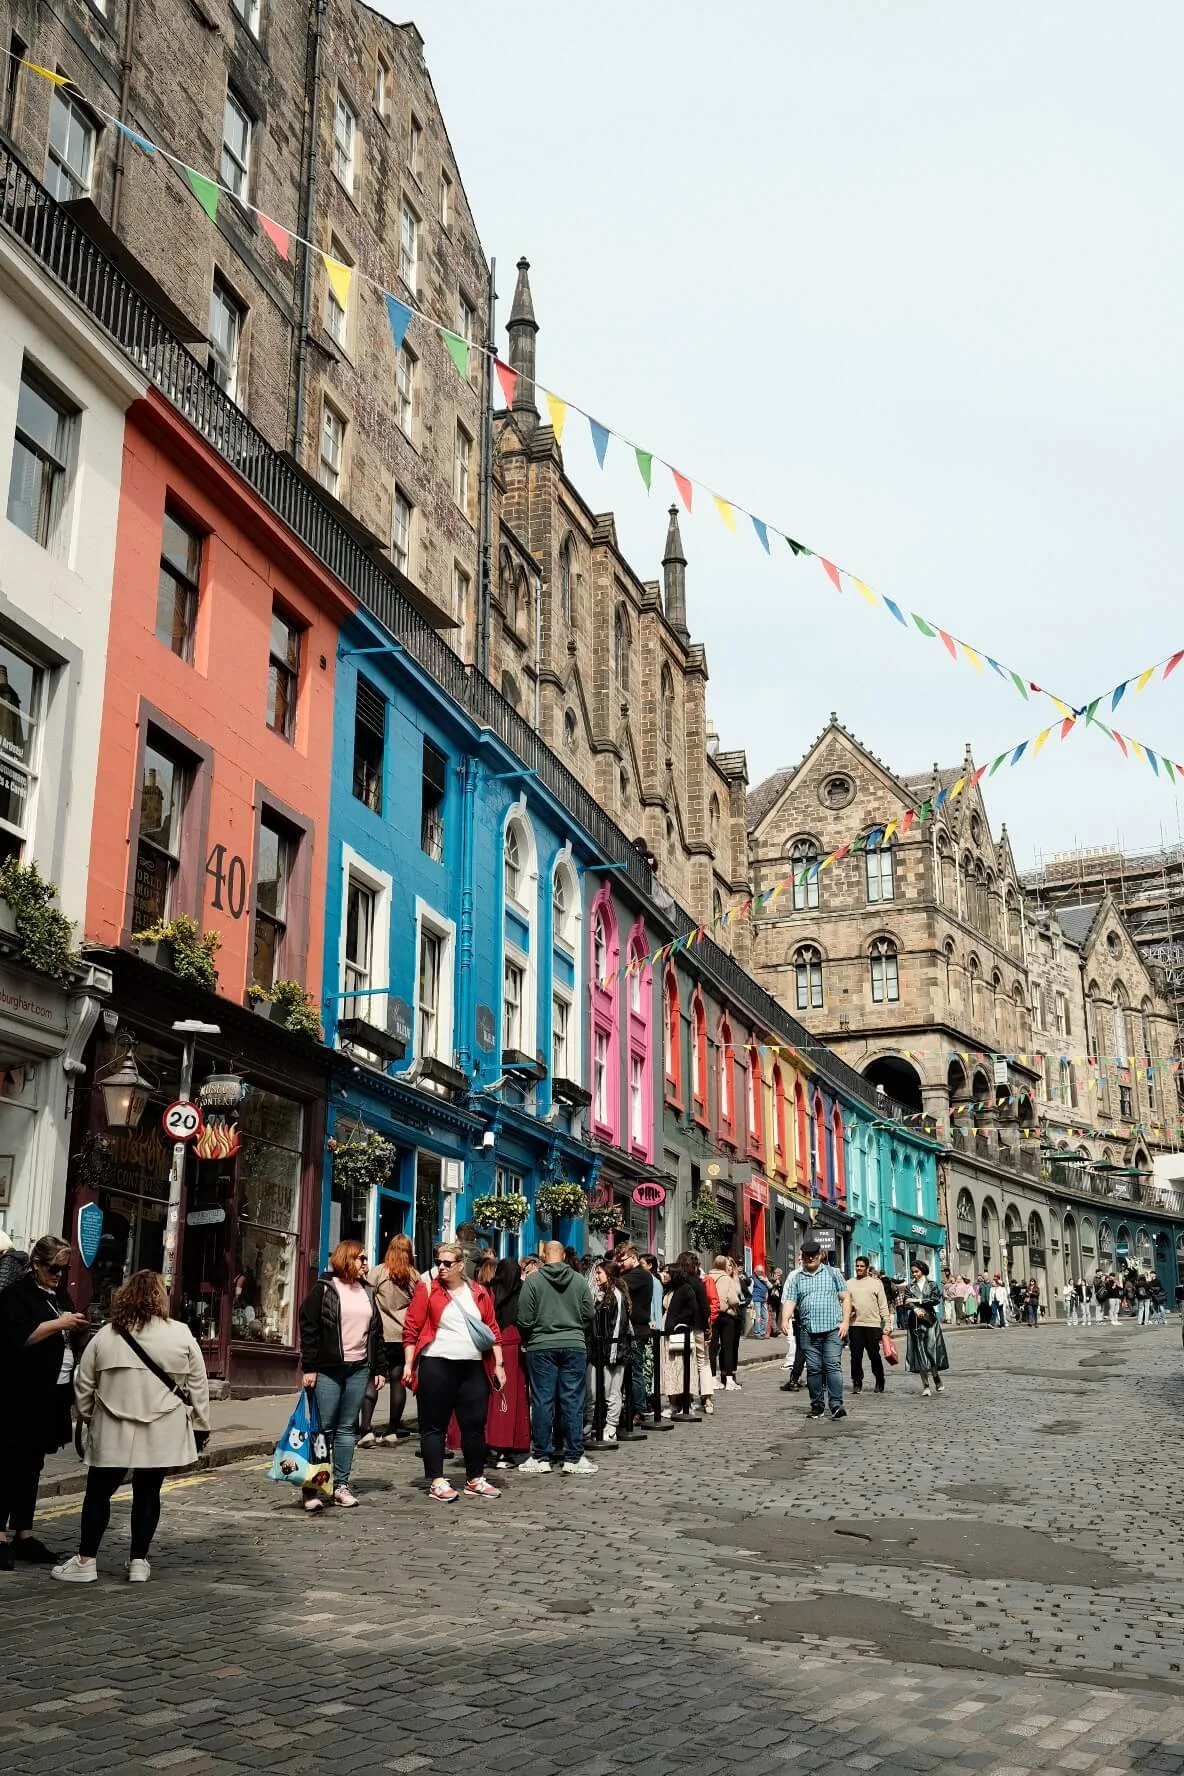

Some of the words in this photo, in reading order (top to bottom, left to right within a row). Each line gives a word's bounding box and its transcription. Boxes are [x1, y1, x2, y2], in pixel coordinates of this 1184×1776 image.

[206, 844, 246, 920] 40
[0, 987, 53, 1019] burghart.com
[169, 1111, 197, 1130] 20
